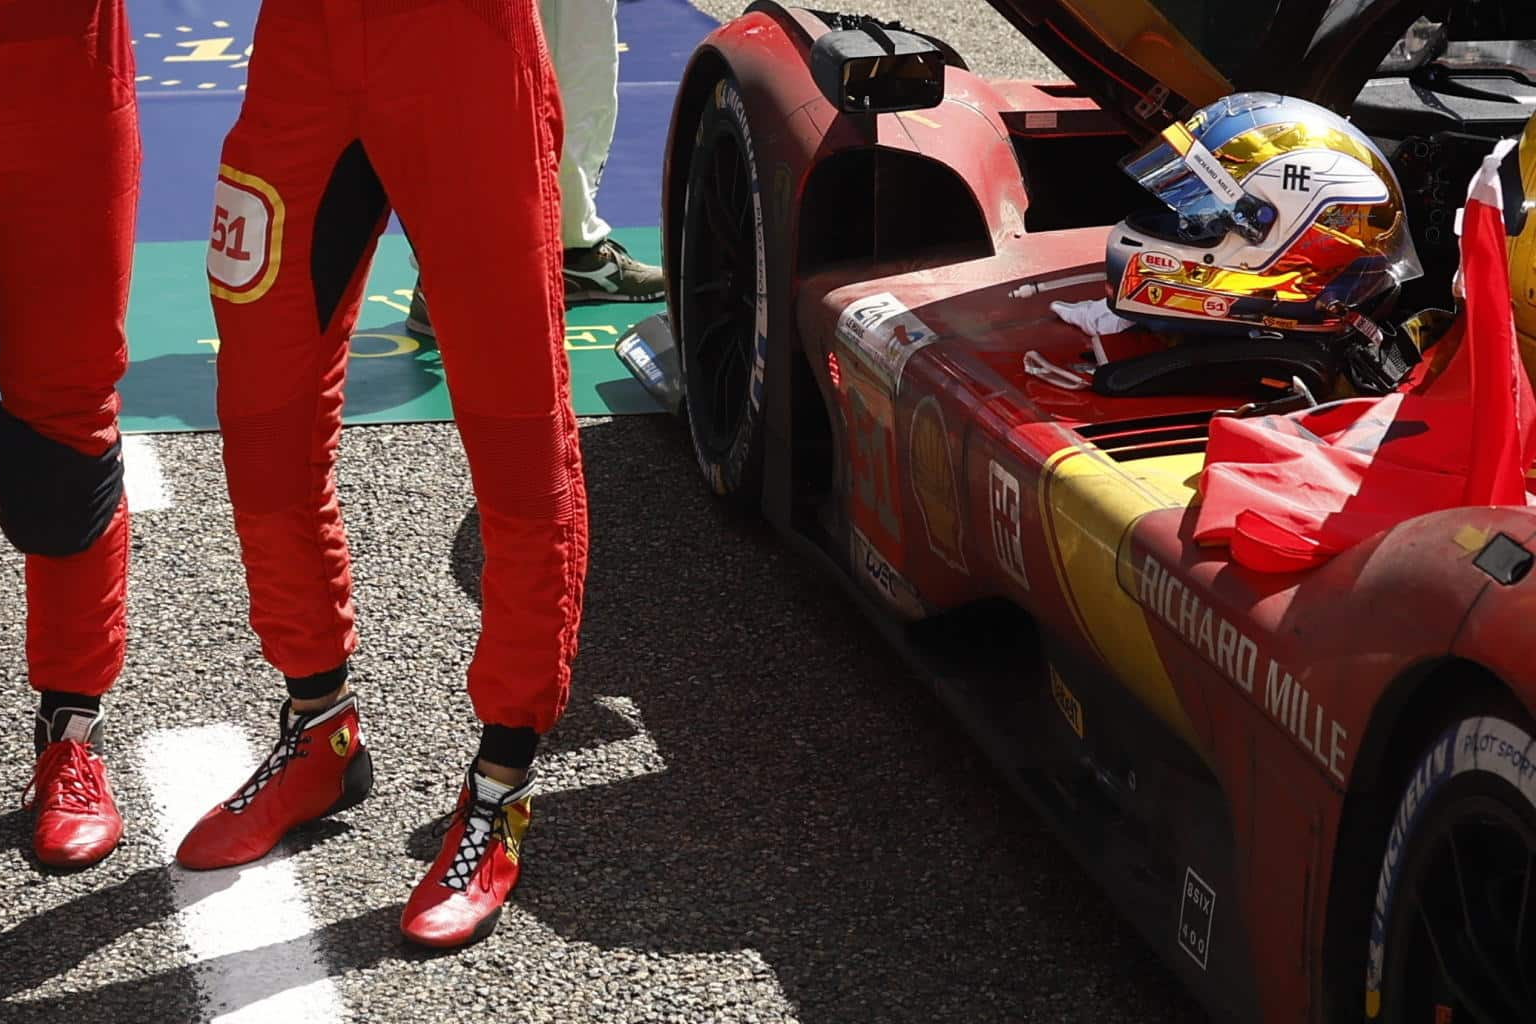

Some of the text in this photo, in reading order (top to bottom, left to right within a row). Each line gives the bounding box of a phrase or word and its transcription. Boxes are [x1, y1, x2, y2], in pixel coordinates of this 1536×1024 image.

[1194, 154, 1235, 198] RICHARD MILLE
[211, 207, 251, 261] 51
[1145, 255, 1176, 269] BELL
[1206, 301, 1226, 312] 51
[1140, 554, 1348, 783] RICHARD MILLE
[1463, 734, 1494, 755] PILOT
[1374, 737, 1450, 931] MICHELIN
